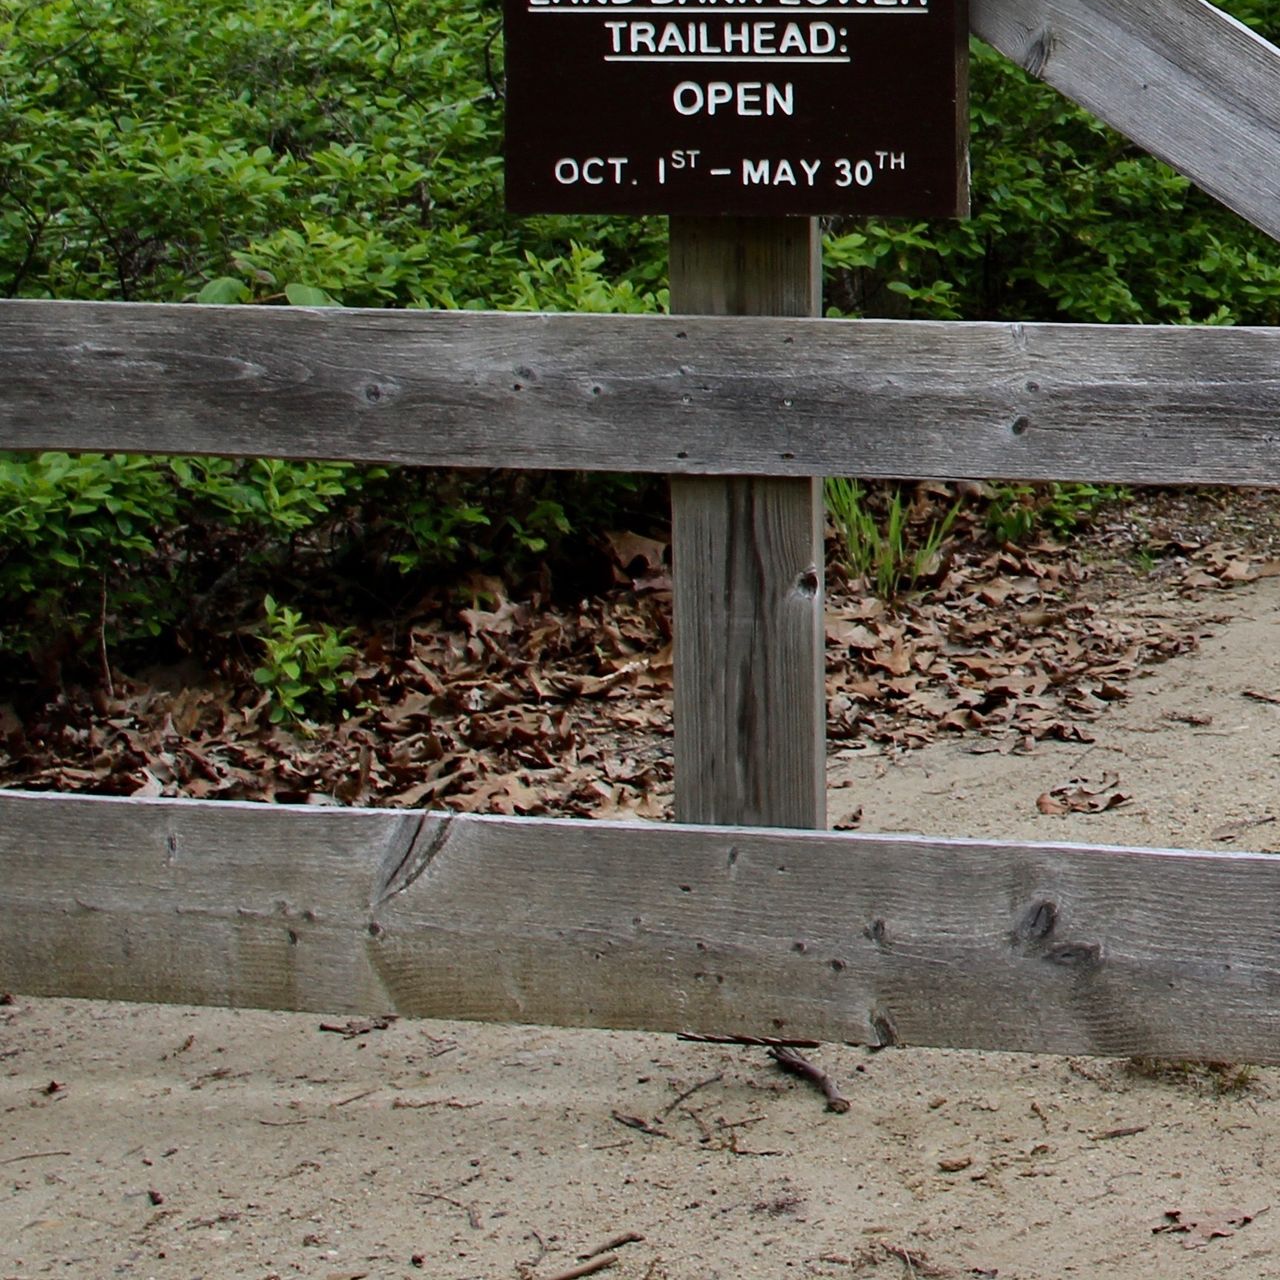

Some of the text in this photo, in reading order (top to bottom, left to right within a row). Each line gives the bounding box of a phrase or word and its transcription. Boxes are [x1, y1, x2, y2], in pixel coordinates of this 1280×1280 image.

[604, 21, 848, 54] TRAILHEAD:
[672, 81, 794, 116] OPEN
[554, 157, 637, 186] OCT.
[658, 150, 700, 184] 1ST
[742, 159, 822, 187] MAY
[834, 151, 906, 187] 30TH
